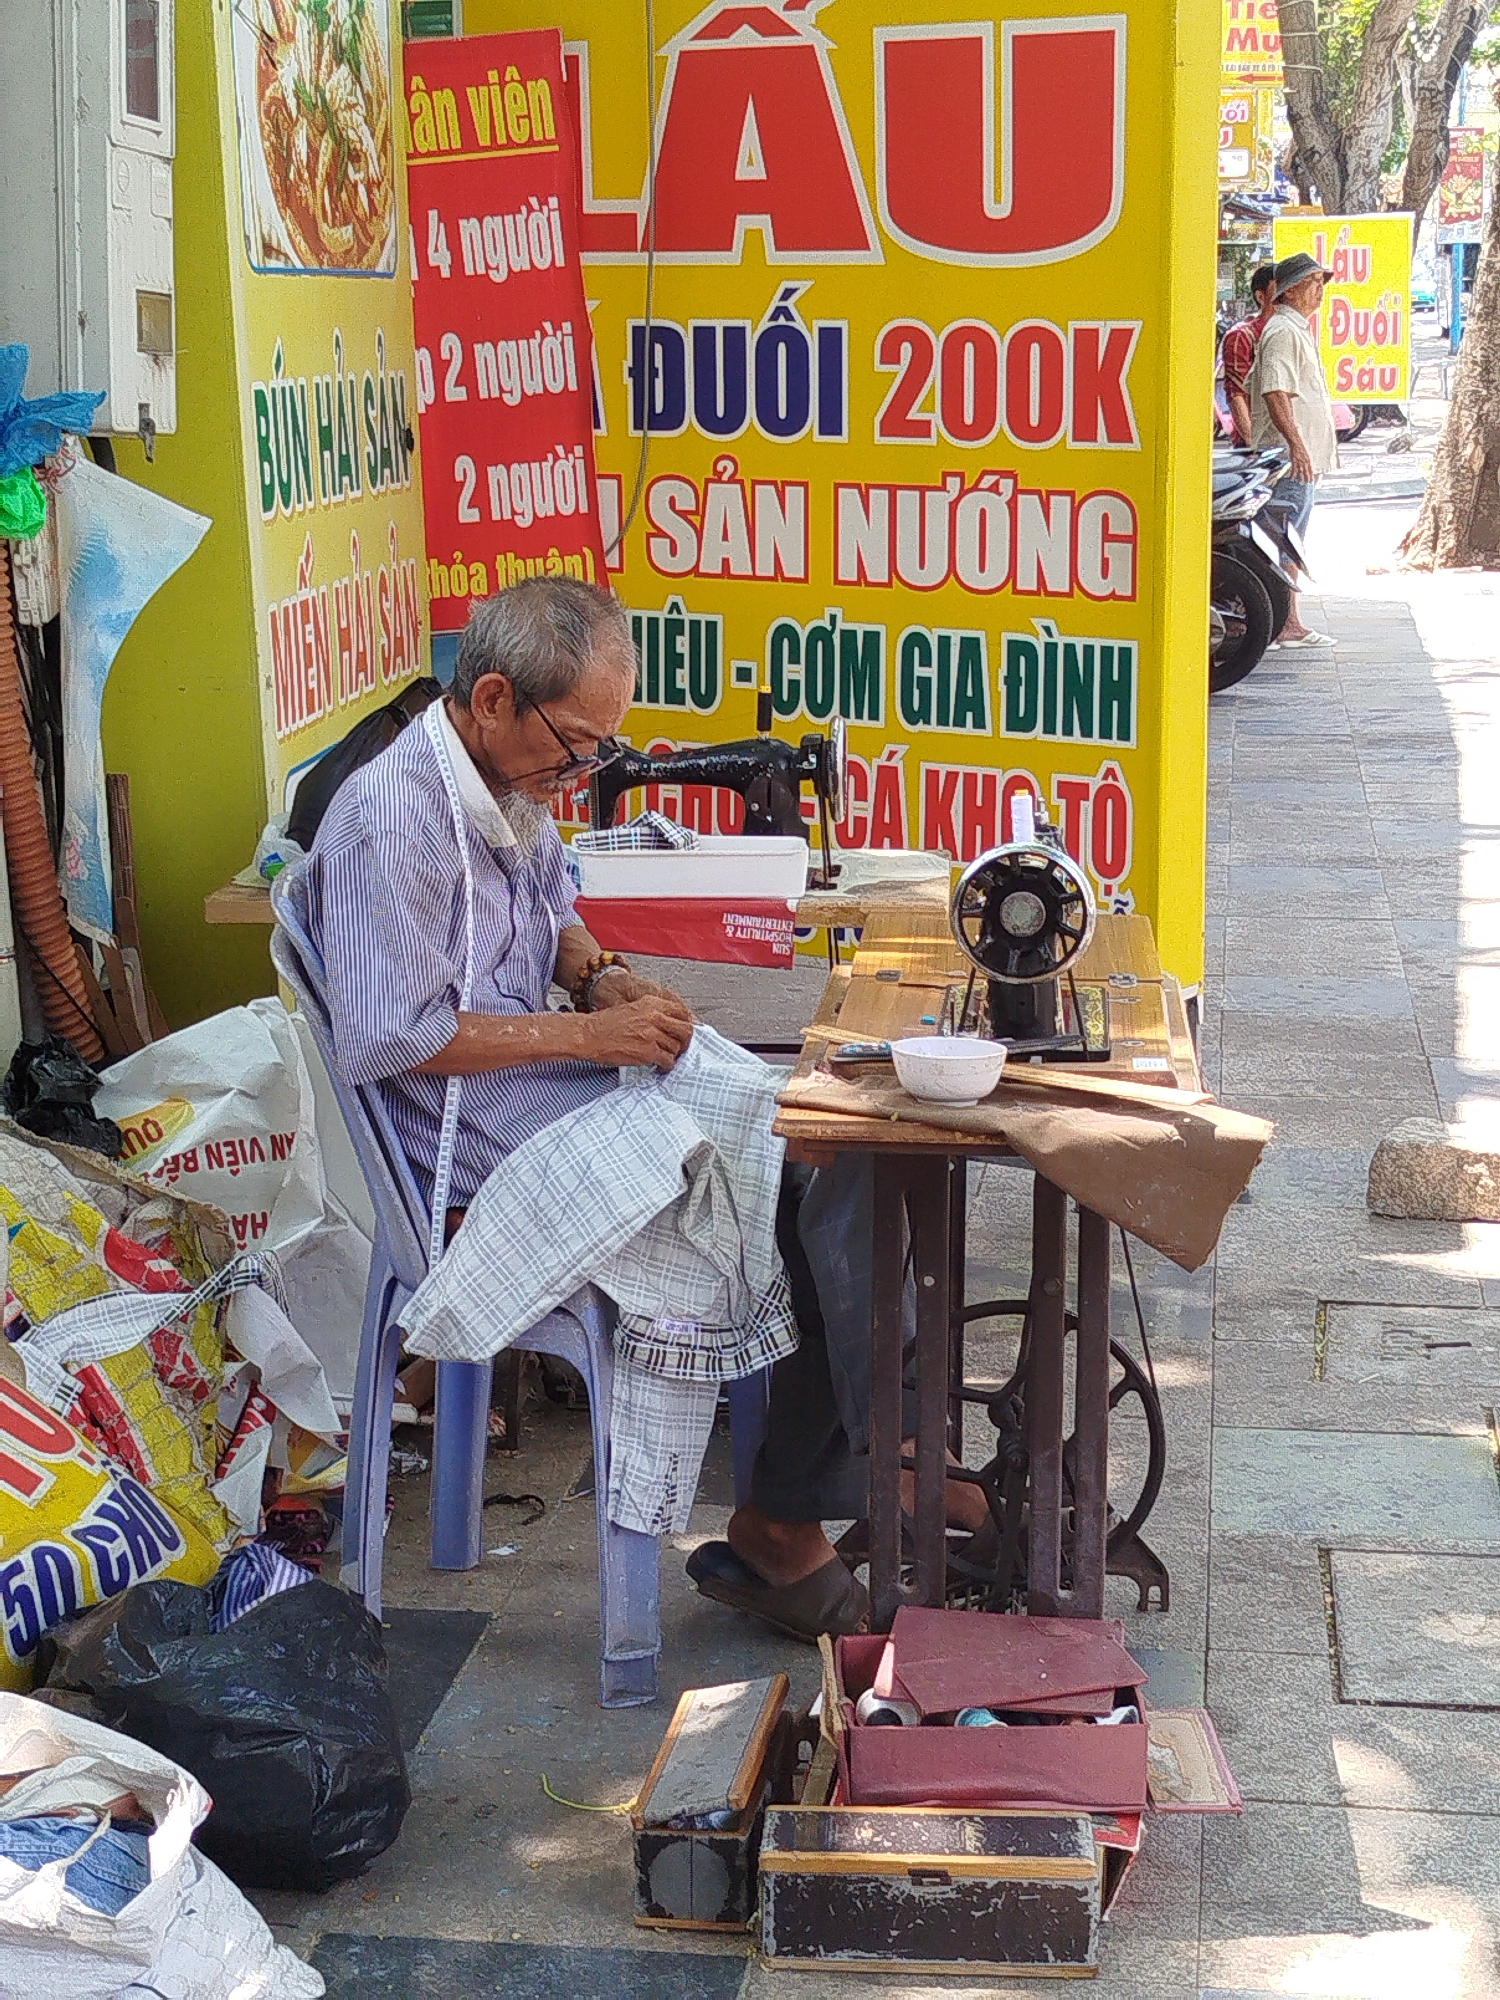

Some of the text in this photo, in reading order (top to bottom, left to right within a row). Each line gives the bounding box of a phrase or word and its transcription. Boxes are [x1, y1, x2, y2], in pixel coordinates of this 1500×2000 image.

[402, 64, 556, 153] ân viên
[568, 0, 1126, 265] ẨU
[427, 208, 451, 278] 4
[458, 194, 566, 283] người
[440, 332, 467, 402] 2
[473, 320, 578, 407] người
[627, 283, 848, 441] ĐUỐI
[876, 322, 1140, 448] 200K
[1330, 291, 1402, 347] Đuối
[254, 337, 312, 519] BÚN
[314, 328, 362, 505] HẢI
[363, 327, 412, 494] SẢN
[454, 454, 480, 523] 2
[487, 444, 589, 529] người
[646, 455, 808, 582] SẢN
[834, 470, 1137, 598] NƯỚNG
[269, 533, 334, 738] MIẾN
[334, 529, 376, 703] HẢI
[378, 521, 422, 684] SẢN
[768, 608, 885, 725] CƠM
[897, 625, 991, 735] GIA
[1001, 619, 1137, 746] ĐÌNH
[836, 746, 908, 849] CÁ
[1053, 761, 1133, 897] TỘ
[772, 943, 791, 956] SUN
[205, 1135, 267, 1177] VIÊN
